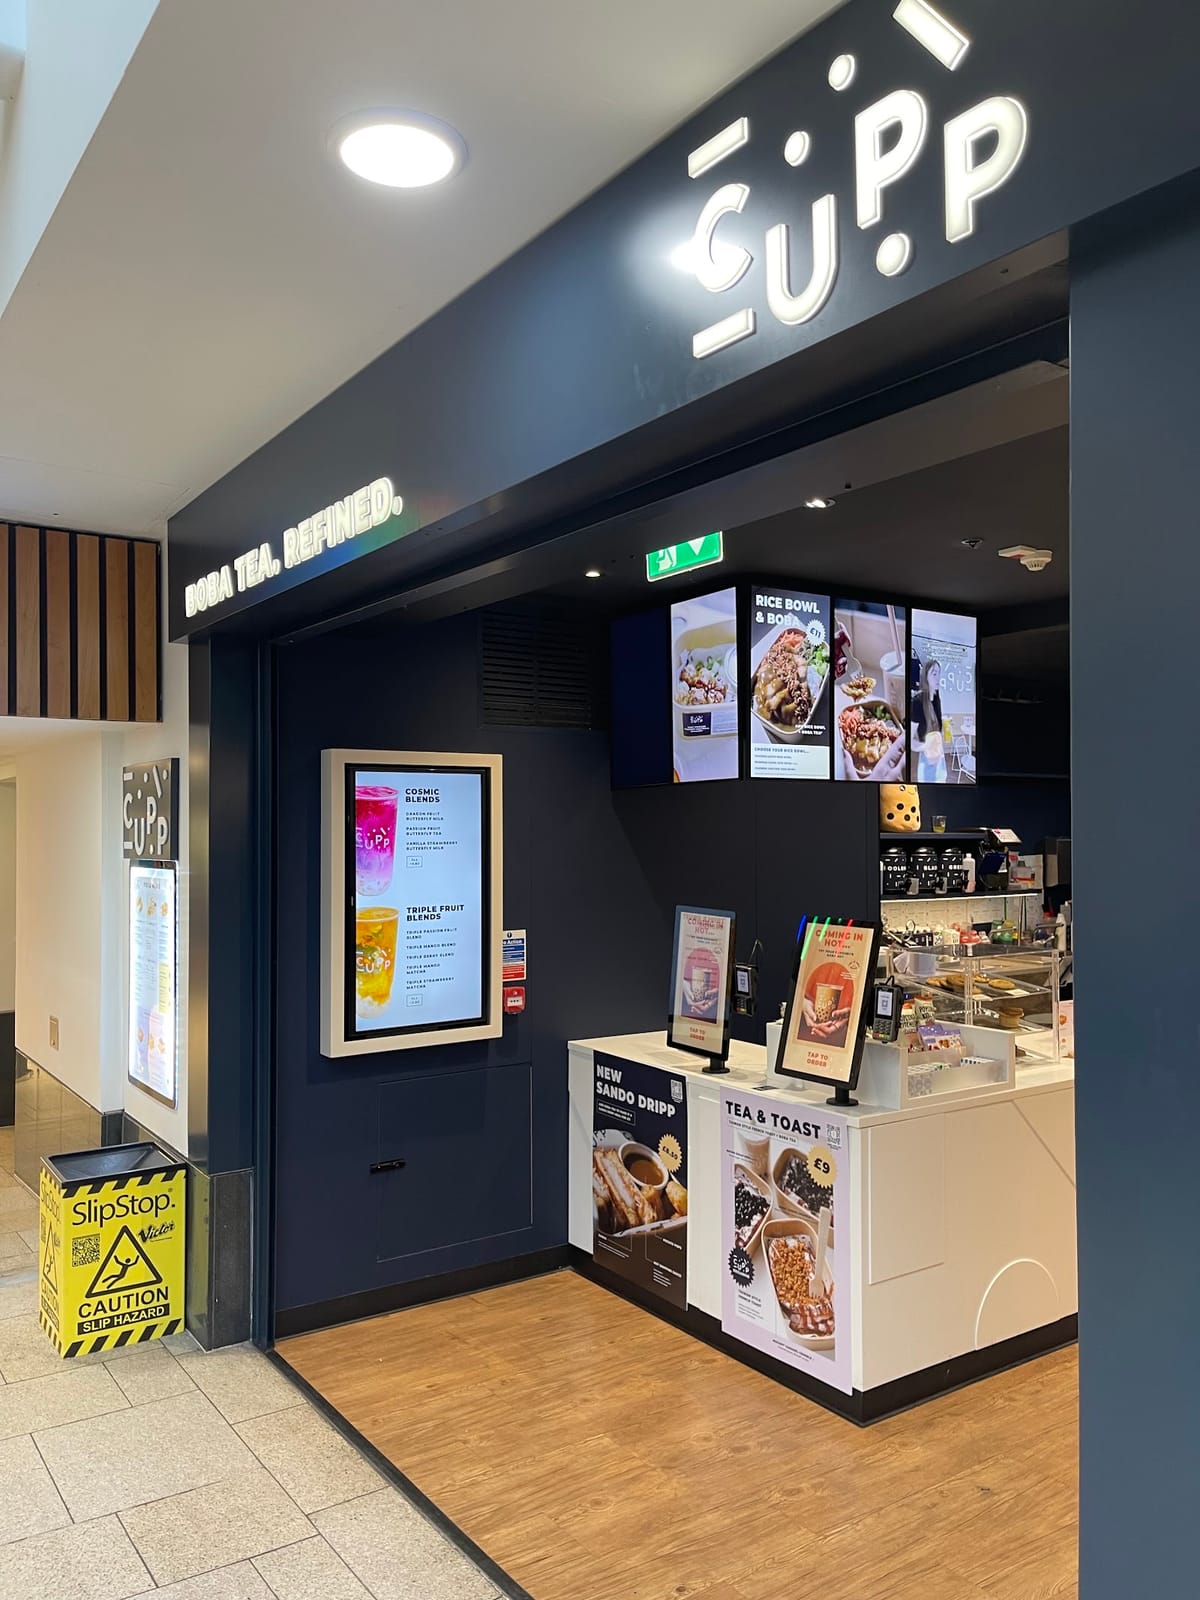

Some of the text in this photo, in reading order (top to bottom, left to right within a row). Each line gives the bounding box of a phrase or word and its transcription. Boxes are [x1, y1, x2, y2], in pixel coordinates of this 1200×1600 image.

[694, 90, 1028, 326] CUPP
[185, 477, 403, 618] BOBA TEA. REFINED.
[756, 595, 820, 614] RICE BOWL
[756, 611, 800, 626] & BOBA
[810, 627, 822, 638] £11
[123, 793, 168, 856] CUPP
[406, 904, 464, 914] TRIPLE FRUIT
[406, 913, 441, 922] BLENDS
[815, 929, 863, 941] COMING IN
[807, 1051, 829, 1061] TAP TO
[807, 1058, 827, 1068] ORDER
[596, 1064, 622, 1083] NEW
[596, 1082, 635, 1105] SANDO
[638, 1094, 676, 1118] DRIPP
[725, 1100, 821, 1139] TEA & TOAST
[813, 1158, 830, 1174] £9
[138, 1220, 175, 1244] Victor
[79, 1286, 168, 1318] CAUTION
[82, 1306, 165, 1333] SLIP HAZARD
